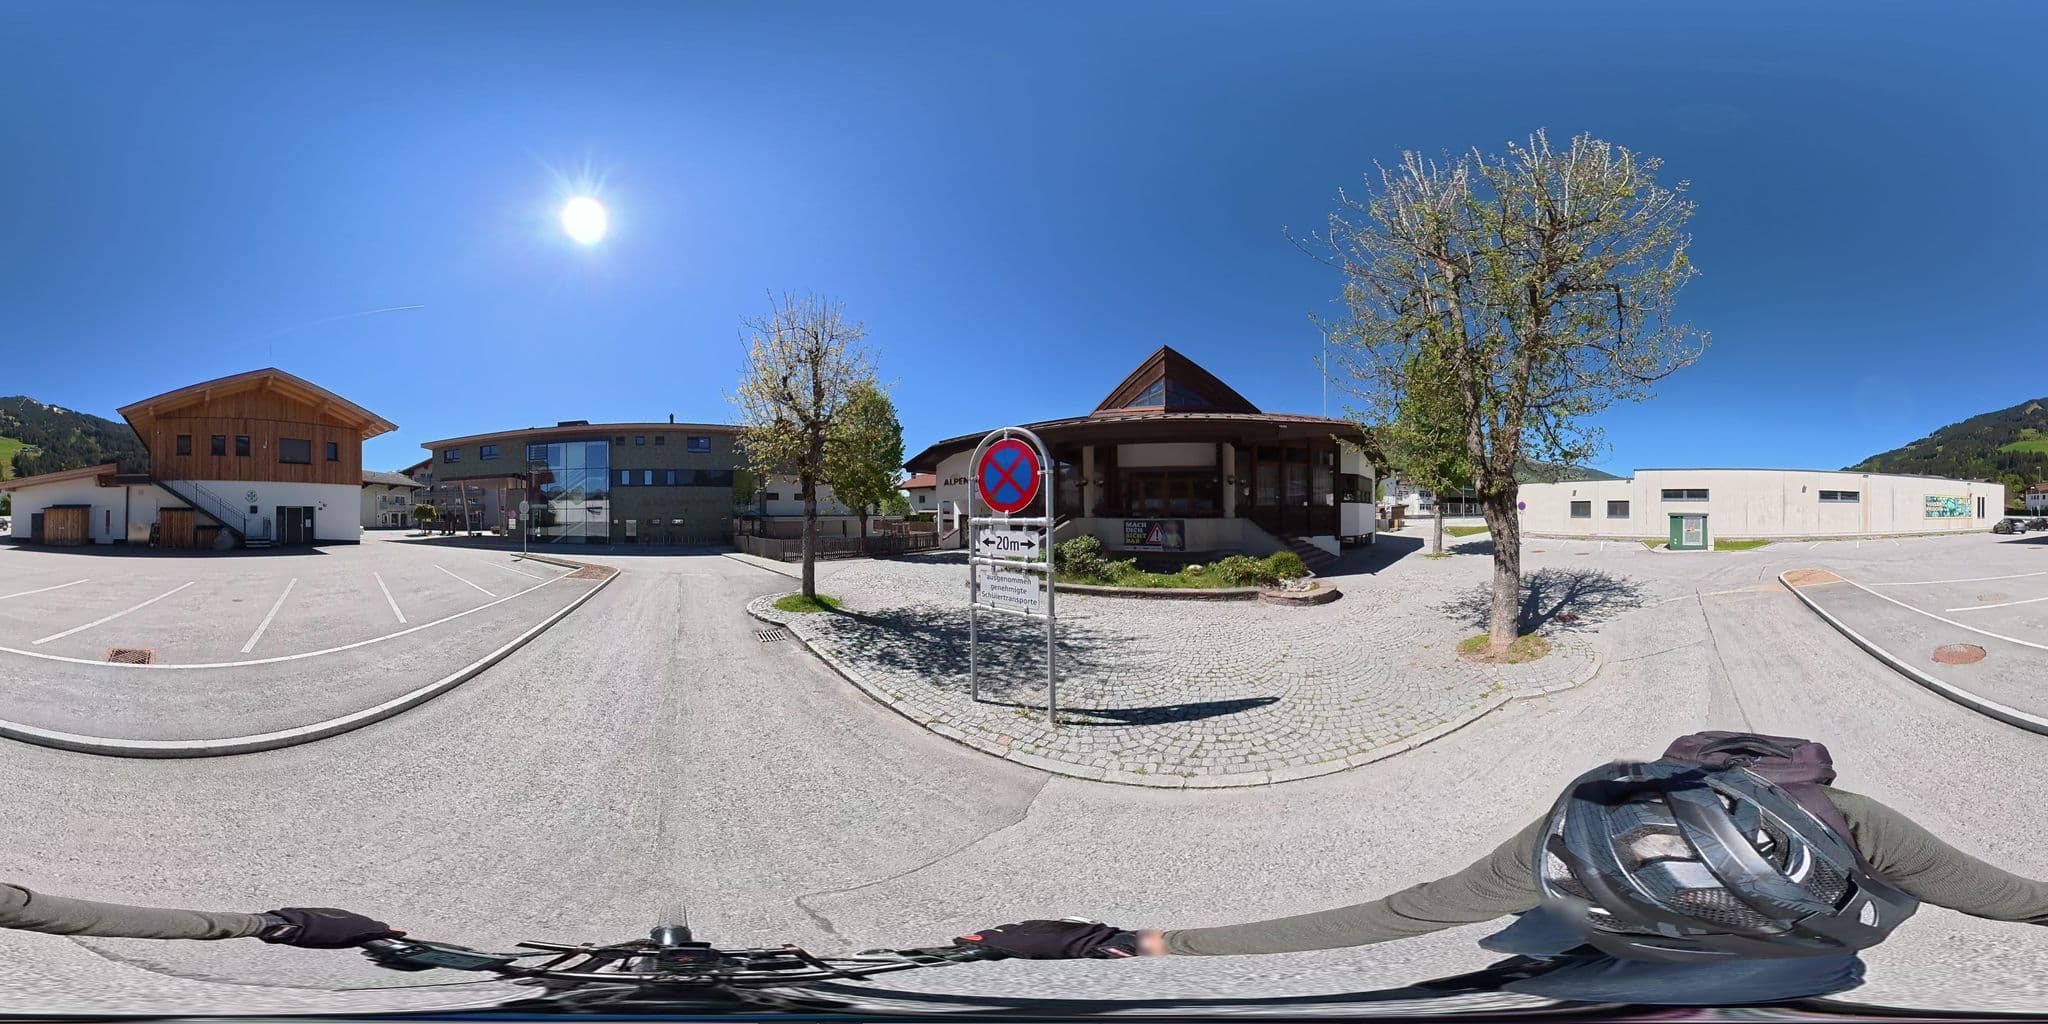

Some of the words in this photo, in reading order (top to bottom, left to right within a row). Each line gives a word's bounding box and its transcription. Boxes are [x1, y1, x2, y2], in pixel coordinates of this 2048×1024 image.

[996, 536, 1020, 551] 20m
[986, 575, 1032, 585] ausgenommen
[990, 584, 1027, 595] genehmigte
[981, 590, 1038, 606] Schülertransporte
